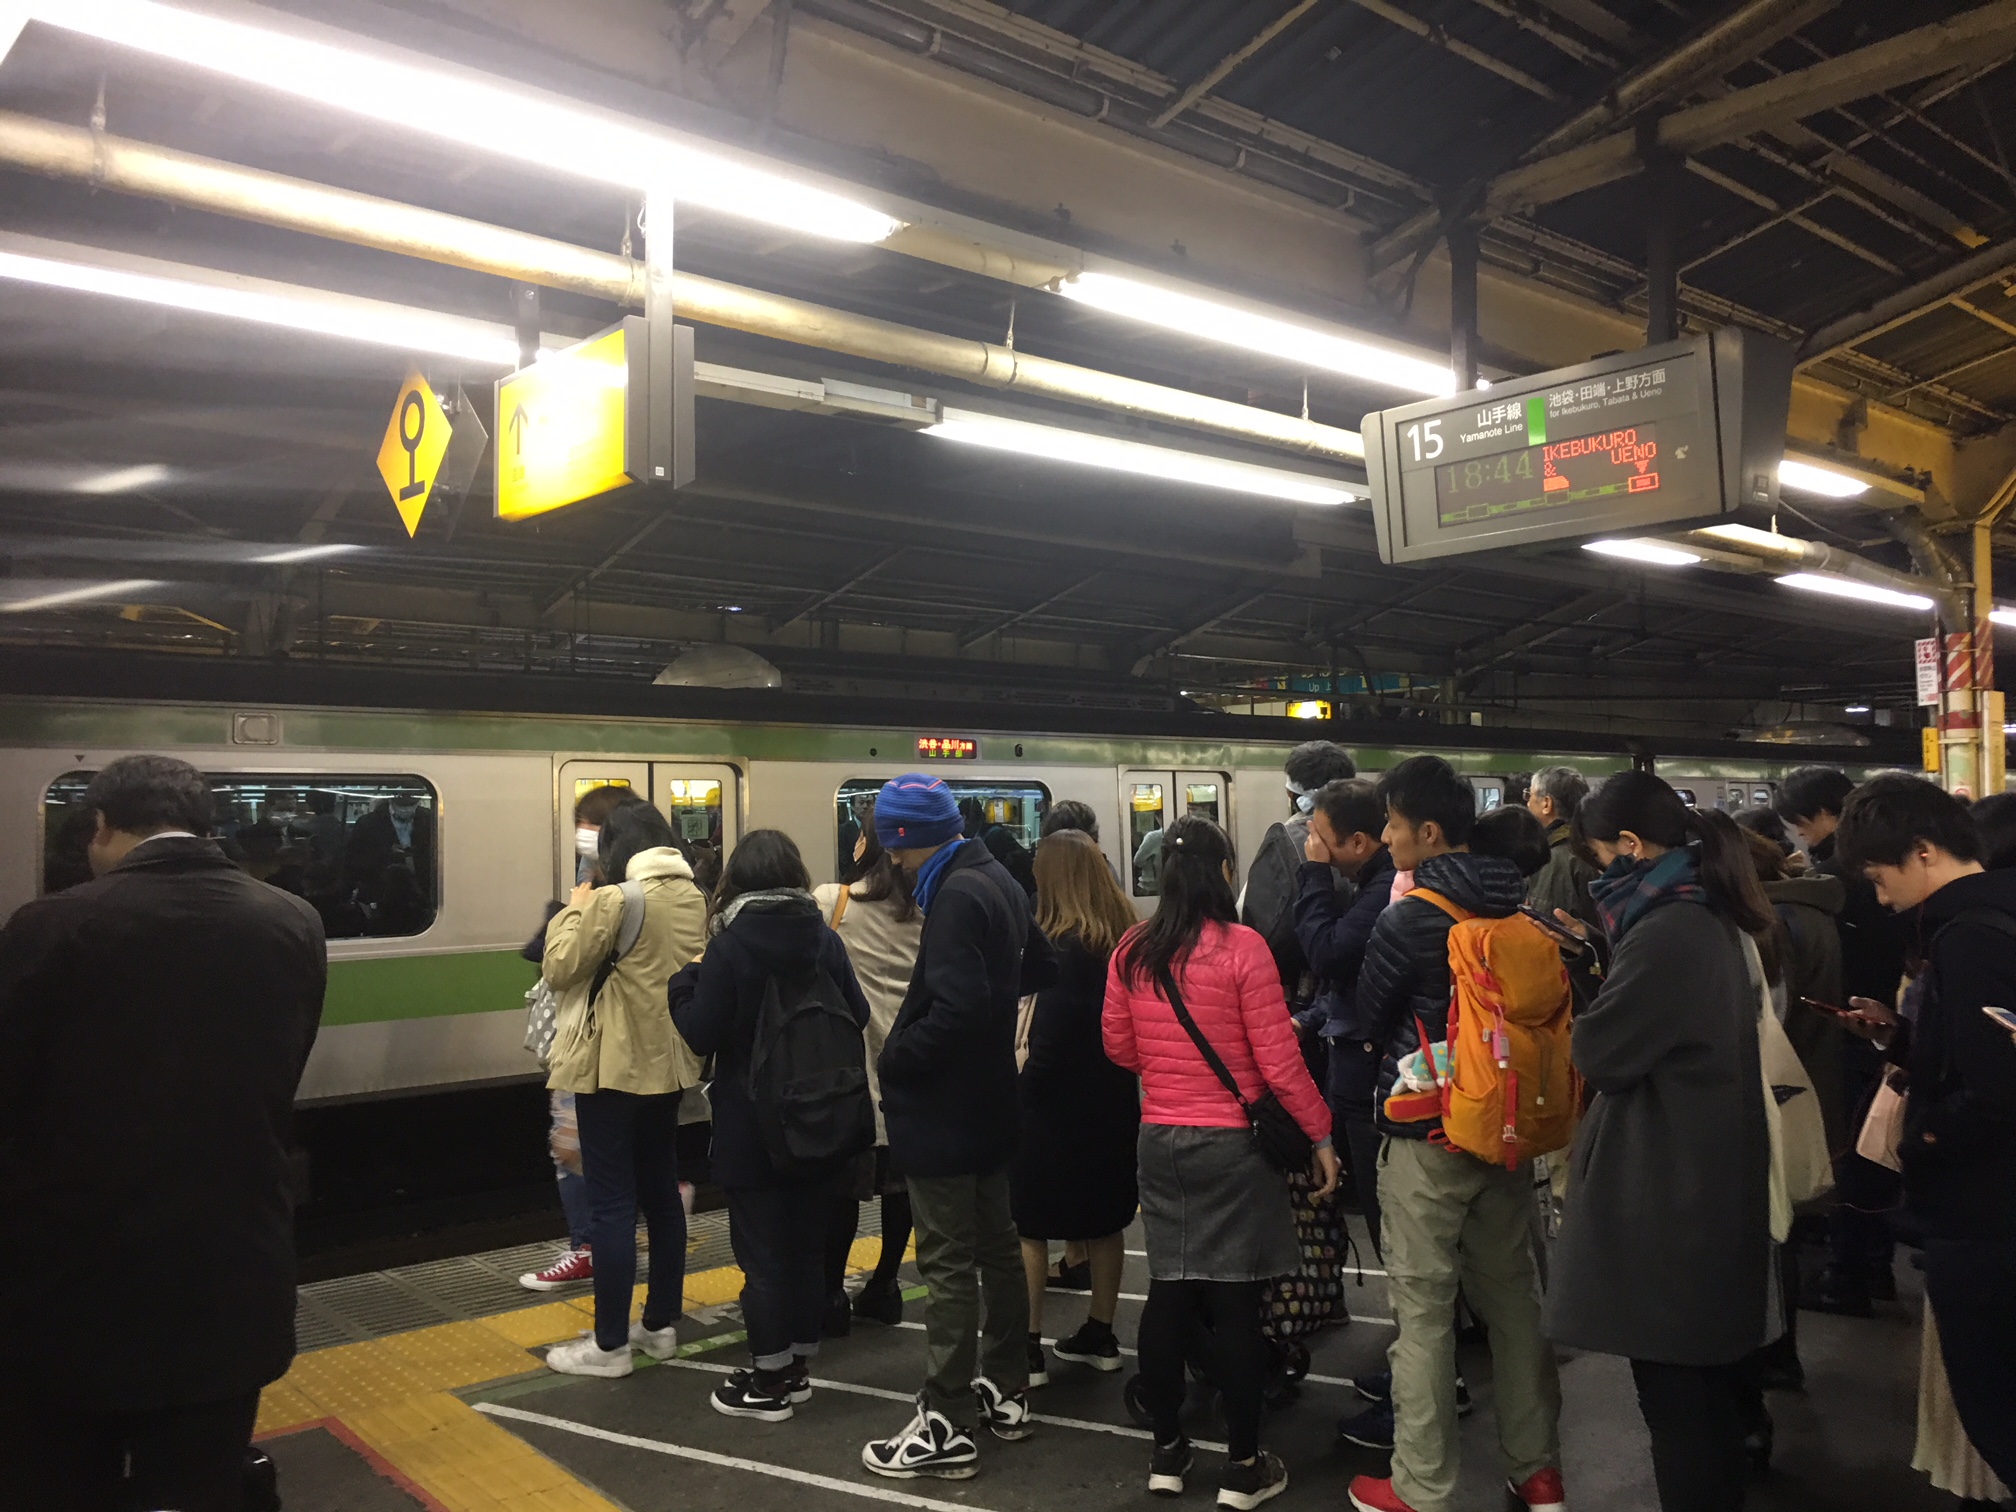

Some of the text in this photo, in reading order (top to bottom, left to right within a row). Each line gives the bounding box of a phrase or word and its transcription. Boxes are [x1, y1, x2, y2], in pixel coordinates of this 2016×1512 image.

[1548, 368, 1666, 408] 池袋・田端・上野方面
[1549, 387, 1663, 418] for Ikebukuro, Tabata & Ueno
[1477, 401, 1522, 428] 山手線
[1406, 419, 1444, 462] 15
[1459, 422, 1523, 444] Yamanote Line
[1542, 428, 1637, 462] IKEBUKURO
[1447, 450, 1533, 494] 18:44
[1543, 441, 1657, 477] & UENO
[1308, 682, 1320, 693] Up
